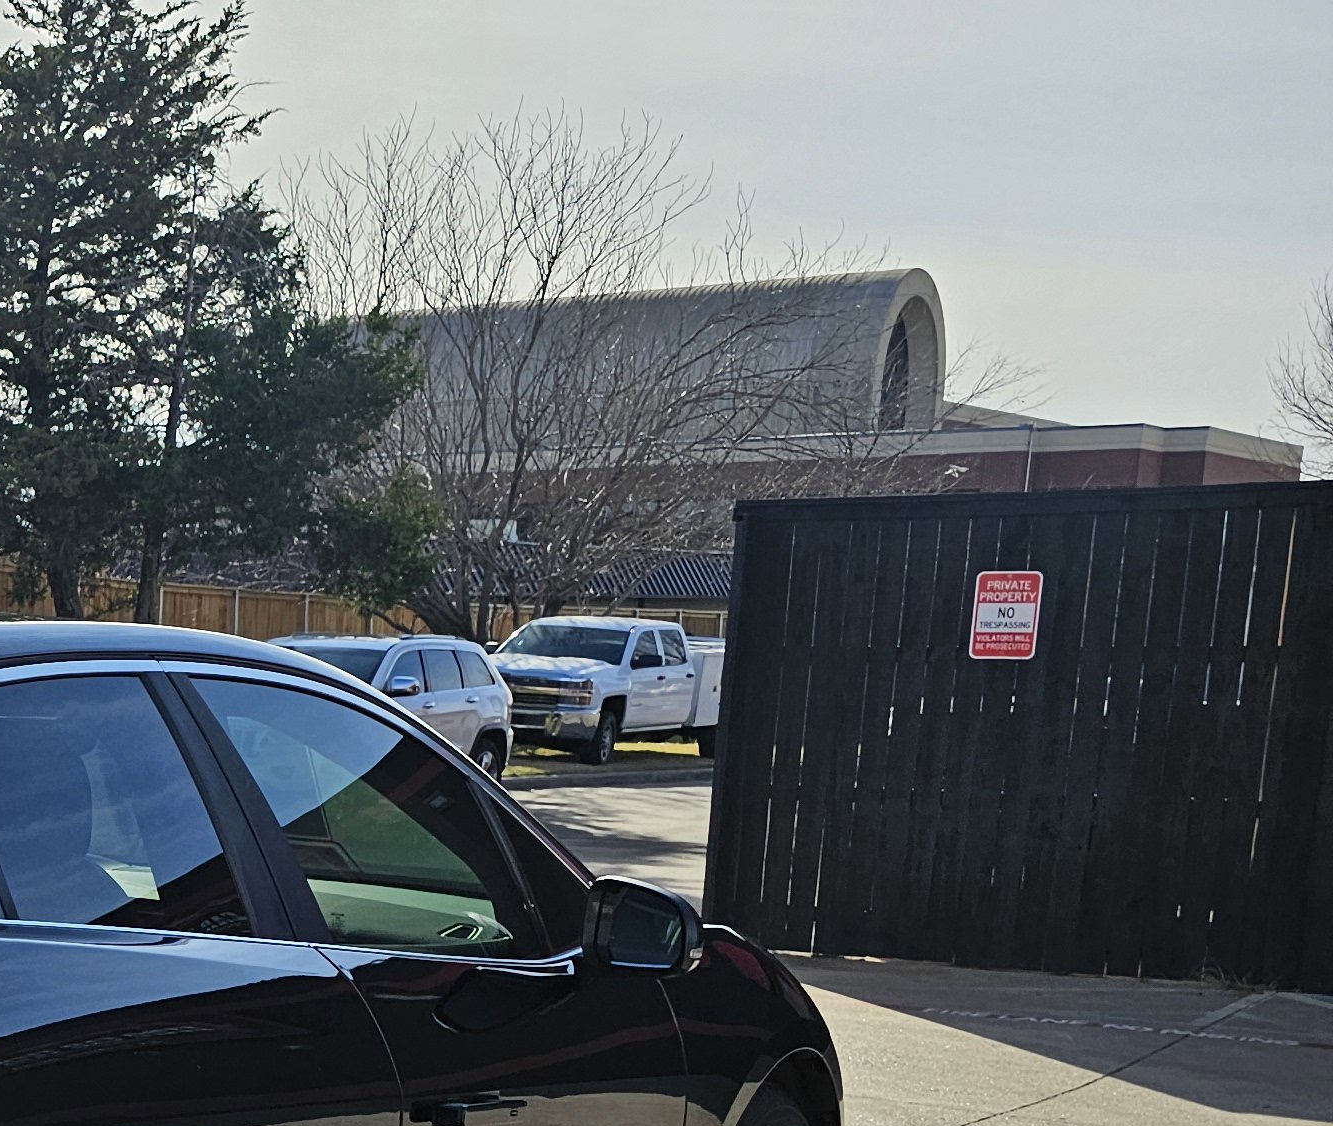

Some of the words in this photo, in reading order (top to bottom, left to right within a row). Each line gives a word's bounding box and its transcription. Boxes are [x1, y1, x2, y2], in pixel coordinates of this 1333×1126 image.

[987, 580, 1032, 590] PRIVATE
[979, 592, 1037, 602] PROPERTY
[997, 607, 1015, 619] NO
[979, 621, 1031, 629] TRESPASSING
[986, 643, 1030, 651] PROSECUTED
